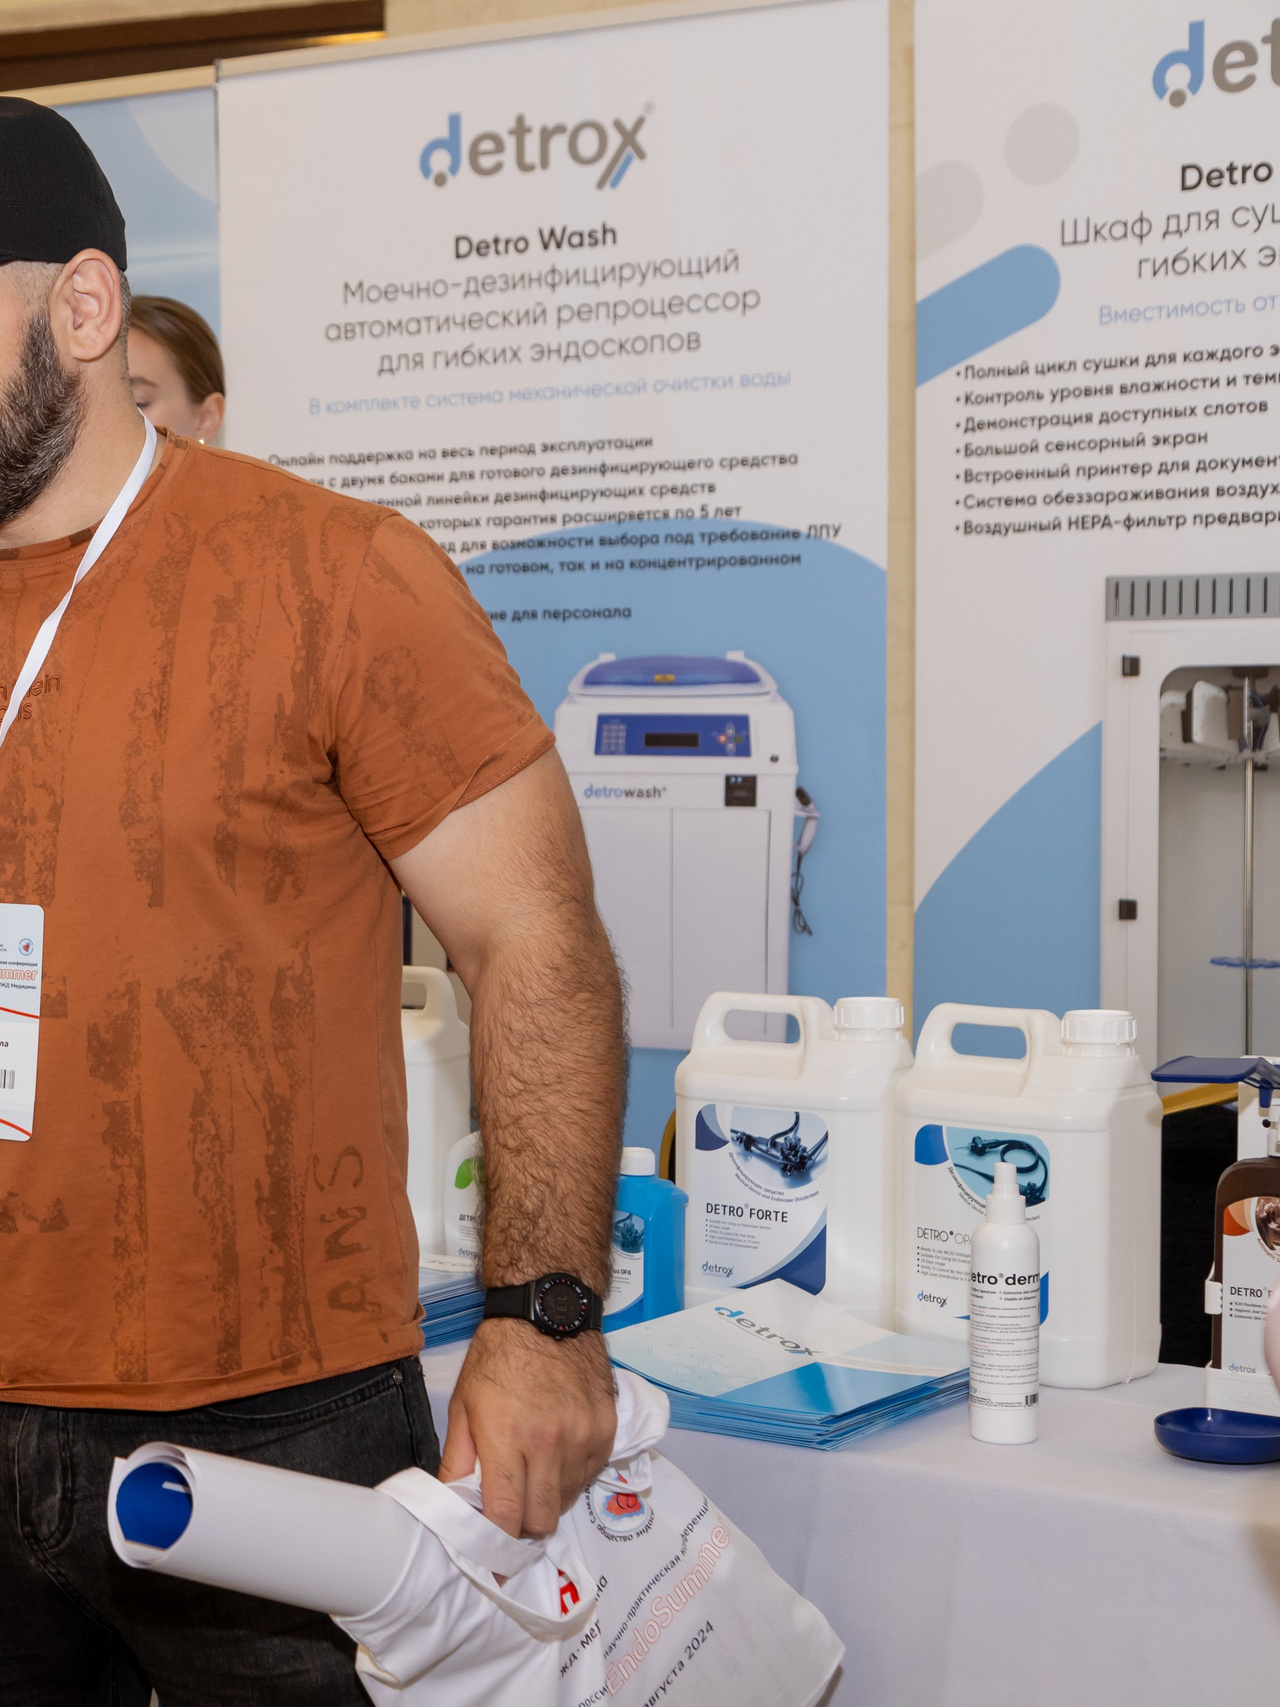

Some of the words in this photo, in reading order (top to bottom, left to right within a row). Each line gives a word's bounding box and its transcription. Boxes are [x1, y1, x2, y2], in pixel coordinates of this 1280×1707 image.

[1152, 16, 1280, 108] det
[419, 112, 648, 190] detrox
[1181, 161, 1274, 191] Detro
[454, 233, 529, 259] Detro
[538, 222, 618, 250] Wash
[1061, 210, 1152, 246] Шкаф
[1163, 209, 1220, 239] для
[343, 248, 740, 305] Моечно-дезинфицирующий
[1138, 247, 1247, 278] гибких
[325, 302, 547, 342] автоматический
[557, 289, 761, 329] репроцессор
[1099, 299, 1246, 326] Вместимость
[1253, 295, 1278, 311] от
[377, 352, 424, 376] для
[433, 342, 522, 369] гибких
[530, 331, 702, 364] эндоскопов
[964, 360, 1029, 379] Полный
[1035, 360, 1077, 376] цикл
[1083, 355, 1139, 373] сушки
[1145, 352, 1177, 368] для
[1183, 345, 1264, 363] каждого
[309, 397, 320, 415] В
[326, 393, 420, 414] комплекте
[426, 389, 503, 407] система
[509, 377, 648, 402] механической
[653, 374, 734, 394] очистки
[740, 370, 791, 388] воды
[964, 389, 1044, 406] Контроль
[1050, 384, 1114, 402] уровня
[1120, 375, 1220, 394] влажности
[1227, 374, 1237, 387] и
[1243, 371, 1280, 386] тем
[964, 411, 1093, 433] Демонстрация
[1099, 404, 1197, 424] доступных
[1204, 400, 1269, 416] слотов
[329, 449, 414, 465] поддержка
[419, 449, 437, 459] на
[442, 447, 474, 458] весь
[479, 442, 536, 458] период
[541, 436, 653, 453] эксплуатации
[964, 439, 1039, 457] Большой
[1045, 433, 1145, 453] сенсорный
[1152, 431, 1208, 448] экран
[329, 477, 337, 487] с
[449, 470, 475, 483] для
[480, 467, 546, 480] готового
[720, 453, 798, 471] средства
[964, 463, 1070, 484] Встроенный
[1076, 462, 1152, 480] принтер
[1158, 459, 1190, 475] для
[1196, 455, 1280, 473] докумен
[650, 481, 716, 498] средств
[964, 494, 1036, 509] Система
[1043, 485, 1209, 505] обеззараживания
[1217, 483, 1280, 499] воздух
[487, 513, 556, 529] гарантия
[700, 504, 709, 518] 5
[714, 505, 741, 518] лет
[964, 517, 1062, 536] Воздушный
[512, 608, 537, 622] для
[543, 606, 631, 622] персонала
[584, 784, 663, 798] detrowash
[706, 1202, 744, 1217] DETRO
[749, 1208, 788, 1223] FORTE
[917, 1227, 949, 1242] DETRO
[702, 1261, 734, 1278] detrox
[971, 1271, 998, 1285] etro
[917, 1290, 948, 1308] detrox
[1230, 1286, 1263, 1298] DETRO
[715, 1306, 822, 1356] detrox
[684, 1620, 714, 1661] 2024
